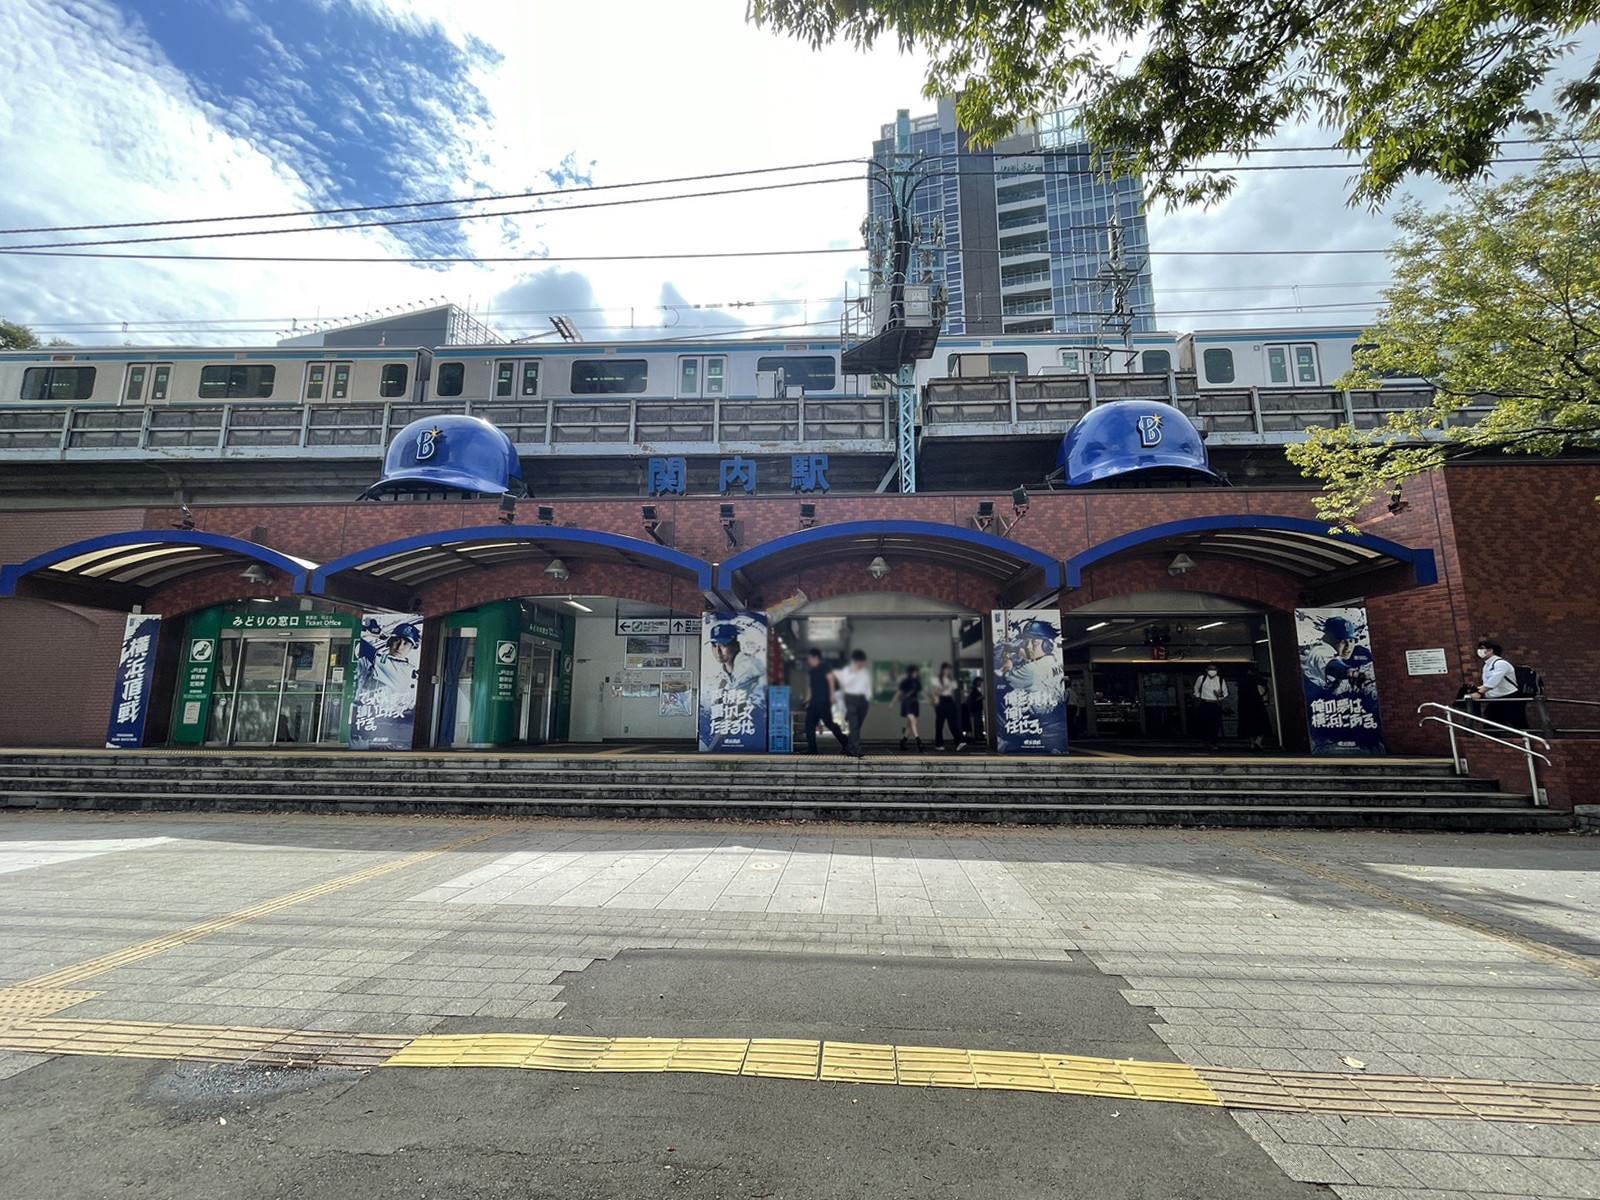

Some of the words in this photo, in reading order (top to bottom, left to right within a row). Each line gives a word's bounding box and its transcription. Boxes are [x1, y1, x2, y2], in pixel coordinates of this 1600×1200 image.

[648, 454, 830, 493] 関内駅
[232, 615, 299, 627] みどりの窓口
[117, 634, 151, 723] 横浜頂戦
[1311, 698, 1367, 713] 俺の夢は、
[355, 717, 377, 731] やる。
[709, 719, 756, 736] たまるか。
[1004, 718, 1044, 735] 任せろ。
[1311, 713, 1378, 729] 横浜にある。
